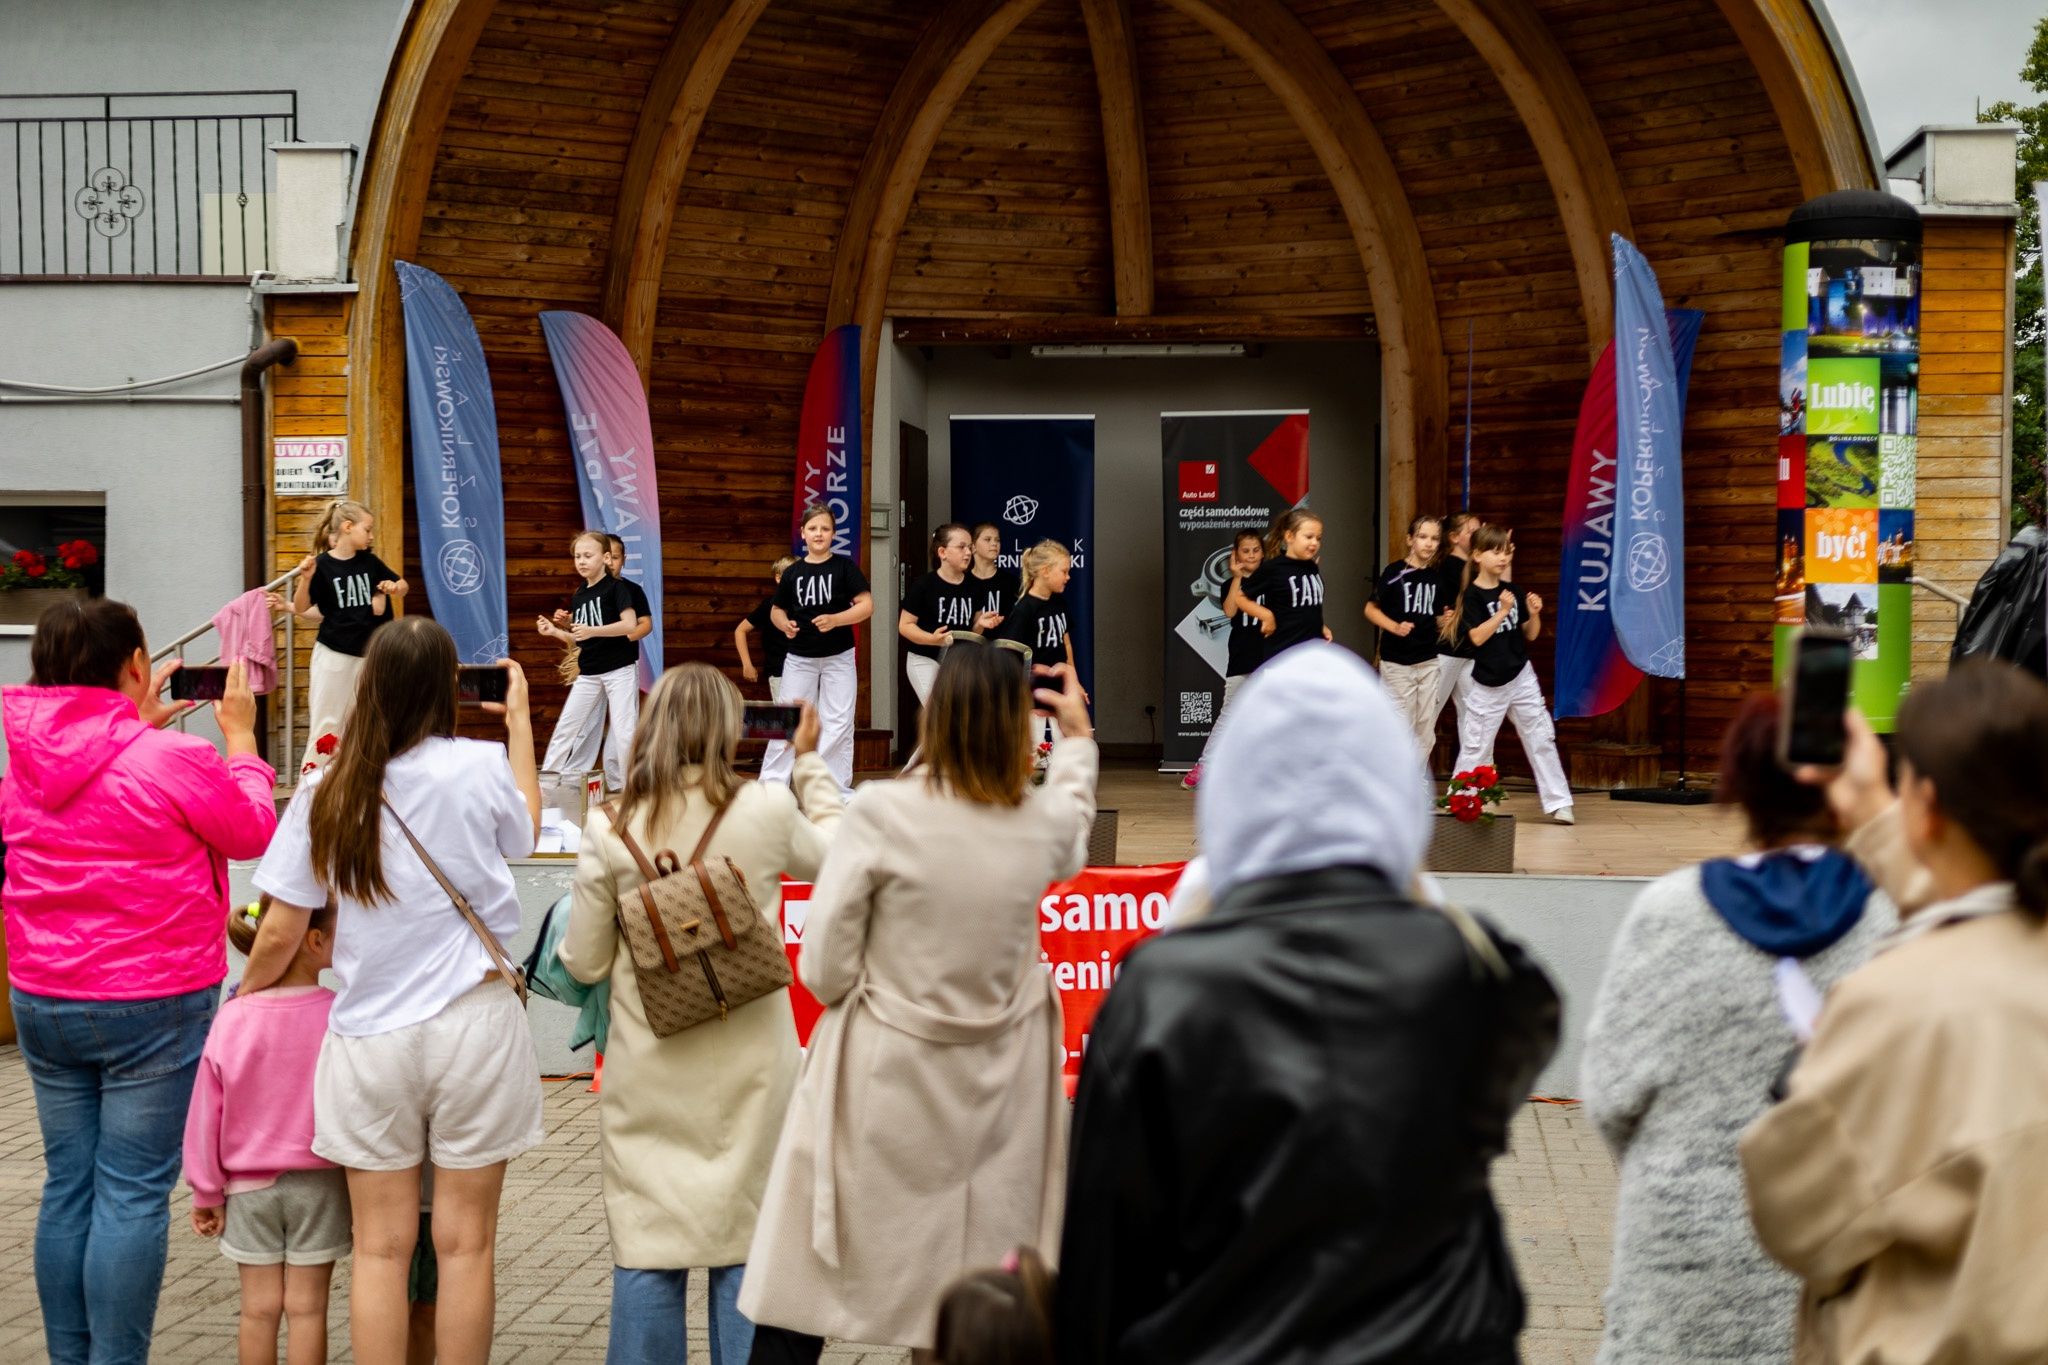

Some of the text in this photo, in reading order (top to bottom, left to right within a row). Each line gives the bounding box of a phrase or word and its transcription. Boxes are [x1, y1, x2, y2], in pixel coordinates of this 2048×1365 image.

[1811, 382, 1875, 413] Lubię
[274, 444, 342, 457] UWAGA
[827, 426, 852, 556] MORZE
[1182, 491, 1216, 499] Auto Land
[1179, 505, 1270, 519] części samochodowe
[1180, 518, 1269, 531] wyposażenie serwisów
[1577, 449, 1616, 611] KUJAWY
[1815, 525, 1868, 562] być!
[333, 572, 372, 609] FAN
[797, 573, 833, 607] FAN
[1288, 573, 1325, 608] FAN
[1403, 581, 1436, 616] FAN
[938, 597, 972, 626] FAN
[1037, 612, 1067, 648] FAN
[1040, 892, 1170, 932] samo
